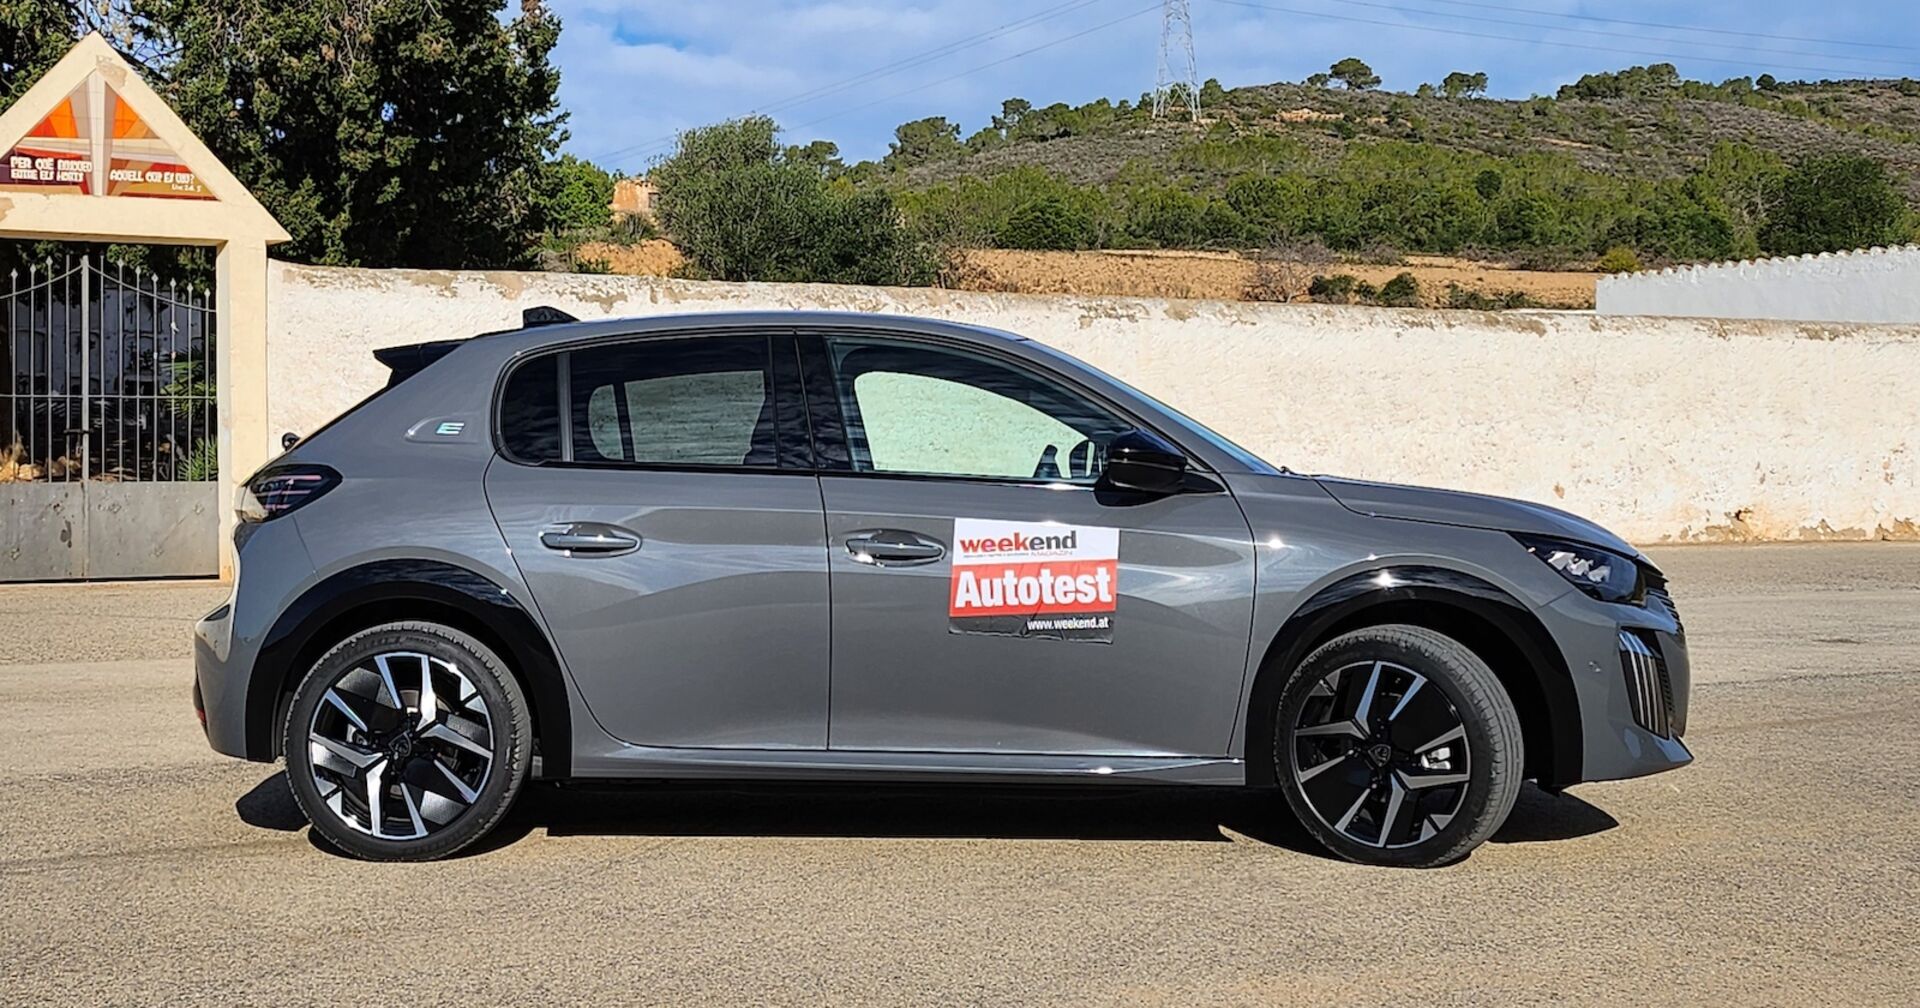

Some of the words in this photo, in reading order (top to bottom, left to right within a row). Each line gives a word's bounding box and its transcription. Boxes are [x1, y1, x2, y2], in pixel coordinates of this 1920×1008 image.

[10, 156, 32, 169] PER
[959, 530, 1078, 553] weekend
[955, 566, 1113, 608] Autotest
[1026, 615, 1110, 631] www.weekend.at
